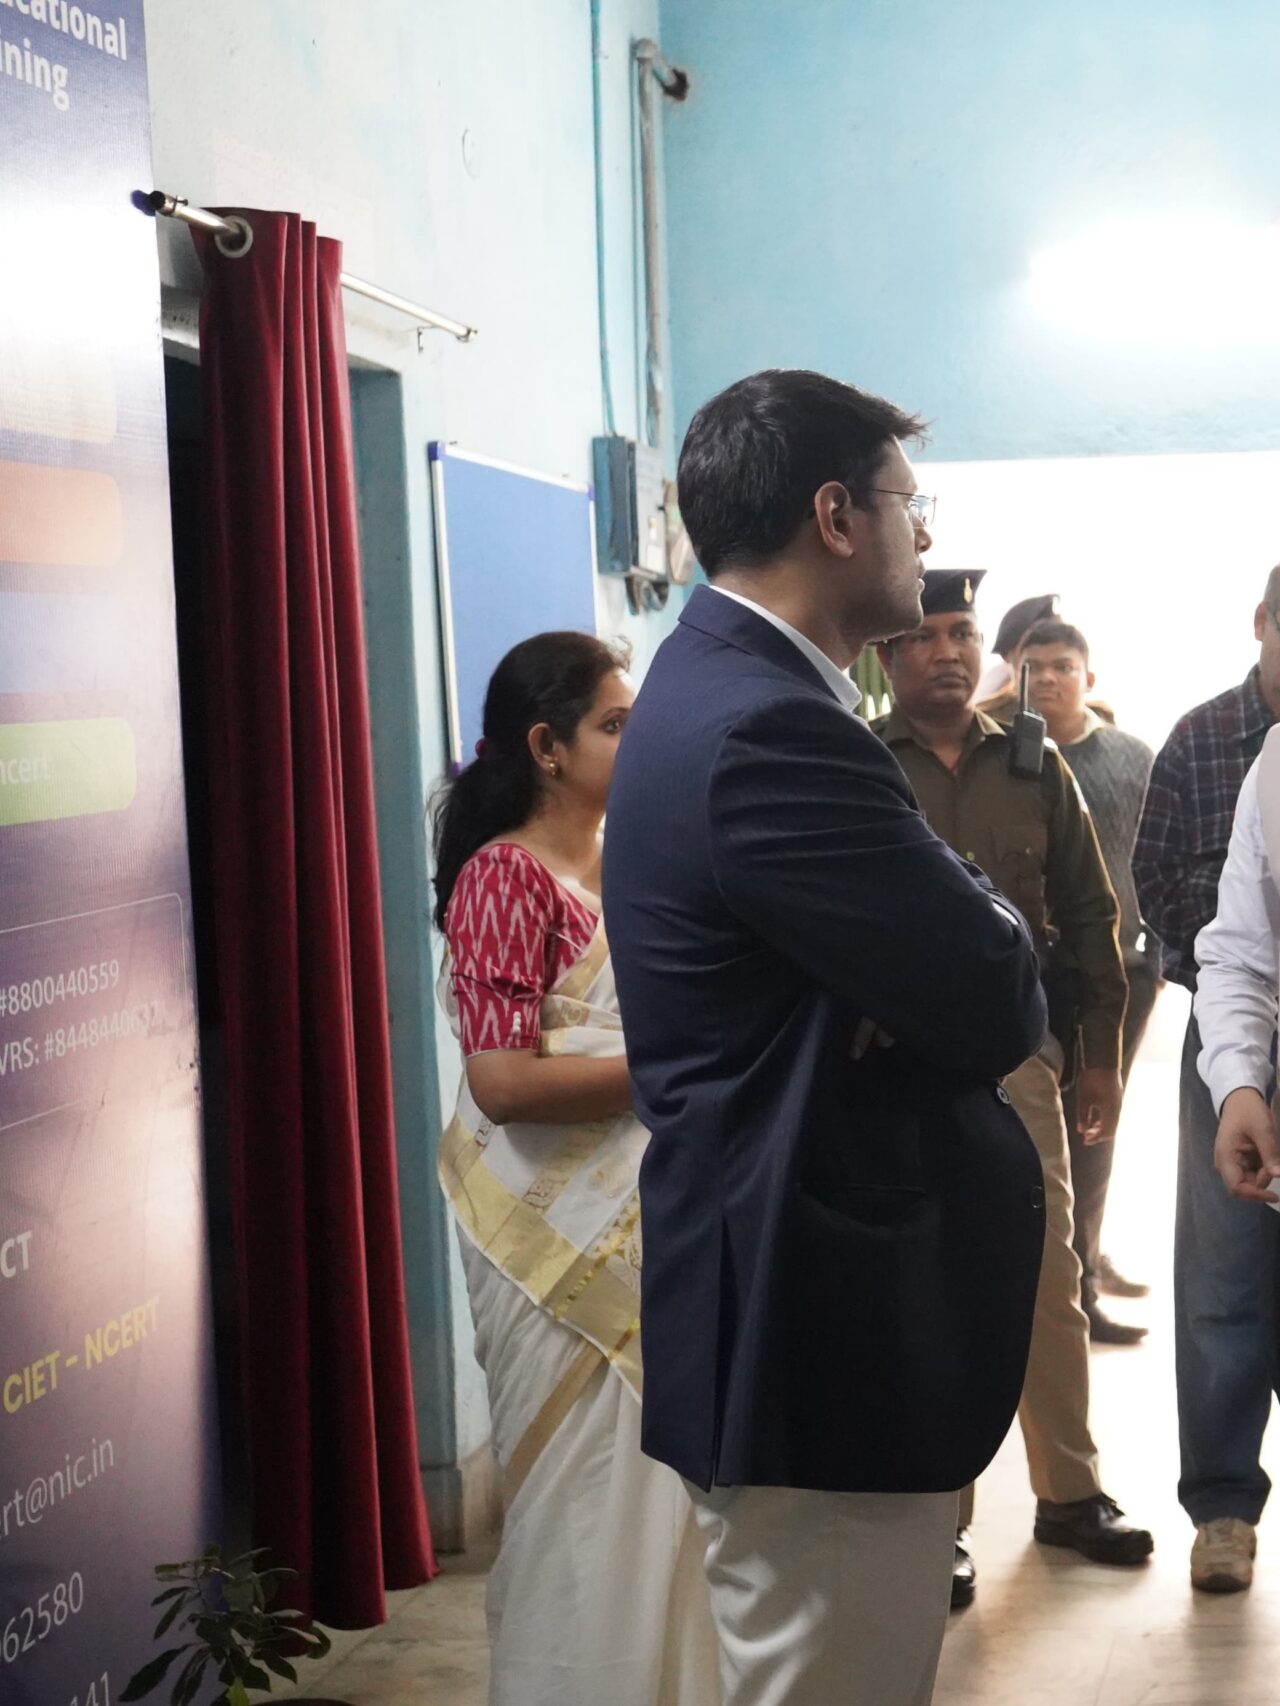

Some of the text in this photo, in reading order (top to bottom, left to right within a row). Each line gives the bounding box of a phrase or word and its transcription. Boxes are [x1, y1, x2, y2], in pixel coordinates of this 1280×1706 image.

[0, 0, 127, 61] ational
[3, 1295, 160, 1414] CIET - NCERT
[0, 1437, 115, 1540] rt@nic.in
[0, 1570, 84, 1664] 62580
